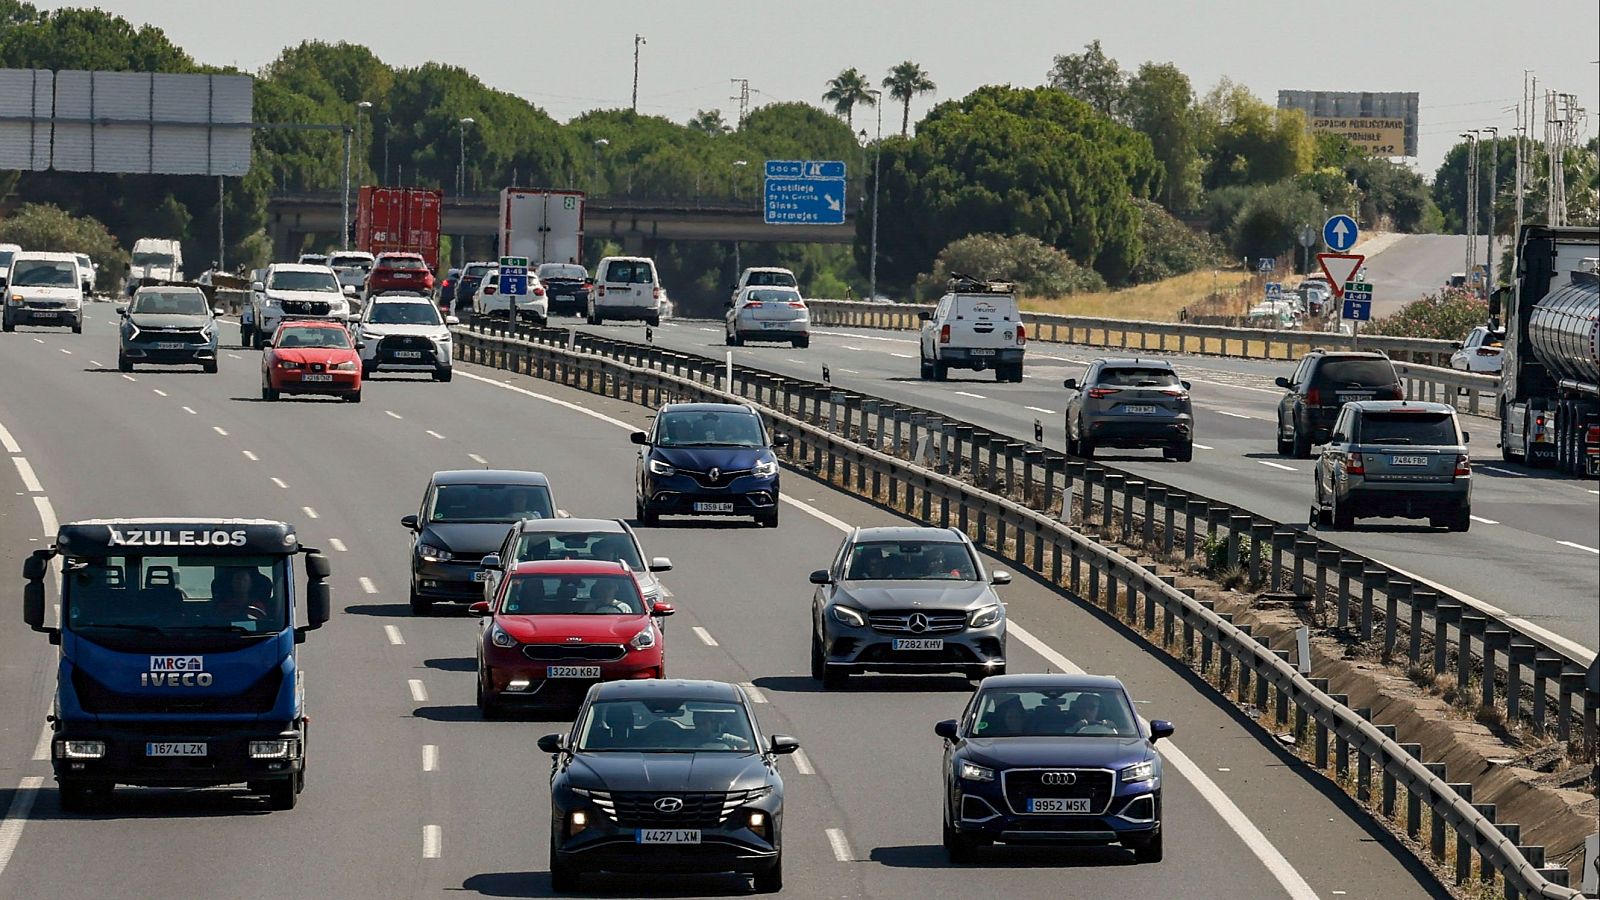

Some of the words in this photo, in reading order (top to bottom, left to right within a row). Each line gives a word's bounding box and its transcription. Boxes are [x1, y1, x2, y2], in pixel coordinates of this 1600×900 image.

[1313, 119, 1347, 128] ESPACIO
[1349, 119, 1403, 129] PUBLICITARIO
[1372, 144, 1395, 153] 542
[770, 183, 814, 193] Castilleja
[769, 201, 799, 209] Gines
[510, 284, 517, 294] 5
[1349, 292, 1367, 300] A-49
[1352, 310, 1360, 319] 5
[1534, 450, 1557, 458] VOL
[1393, 456, 1412, 465] 7484
[700, 503, 718, 511] 1359
[107, 530, 247, 546] AZULEJOS
[899, 640, 922, 649] 7282
[924, 640, 942, 649] KHV
[153, 657, 187, 670] MRG
[552, 667, 578, 677] 3220
[580, 667, 599, 677] KBZ
[140, 672, 213, 687] IVECO
[154, 744, 180, 755] 1674
[183, 744, 204, 755] LZK
[1035, 800, 1064, 811] 9952
[1066, 800, 1087, 811] MSK
[645, 831, 673, 842] 4427
[675, 831, 698, 842] LXM
